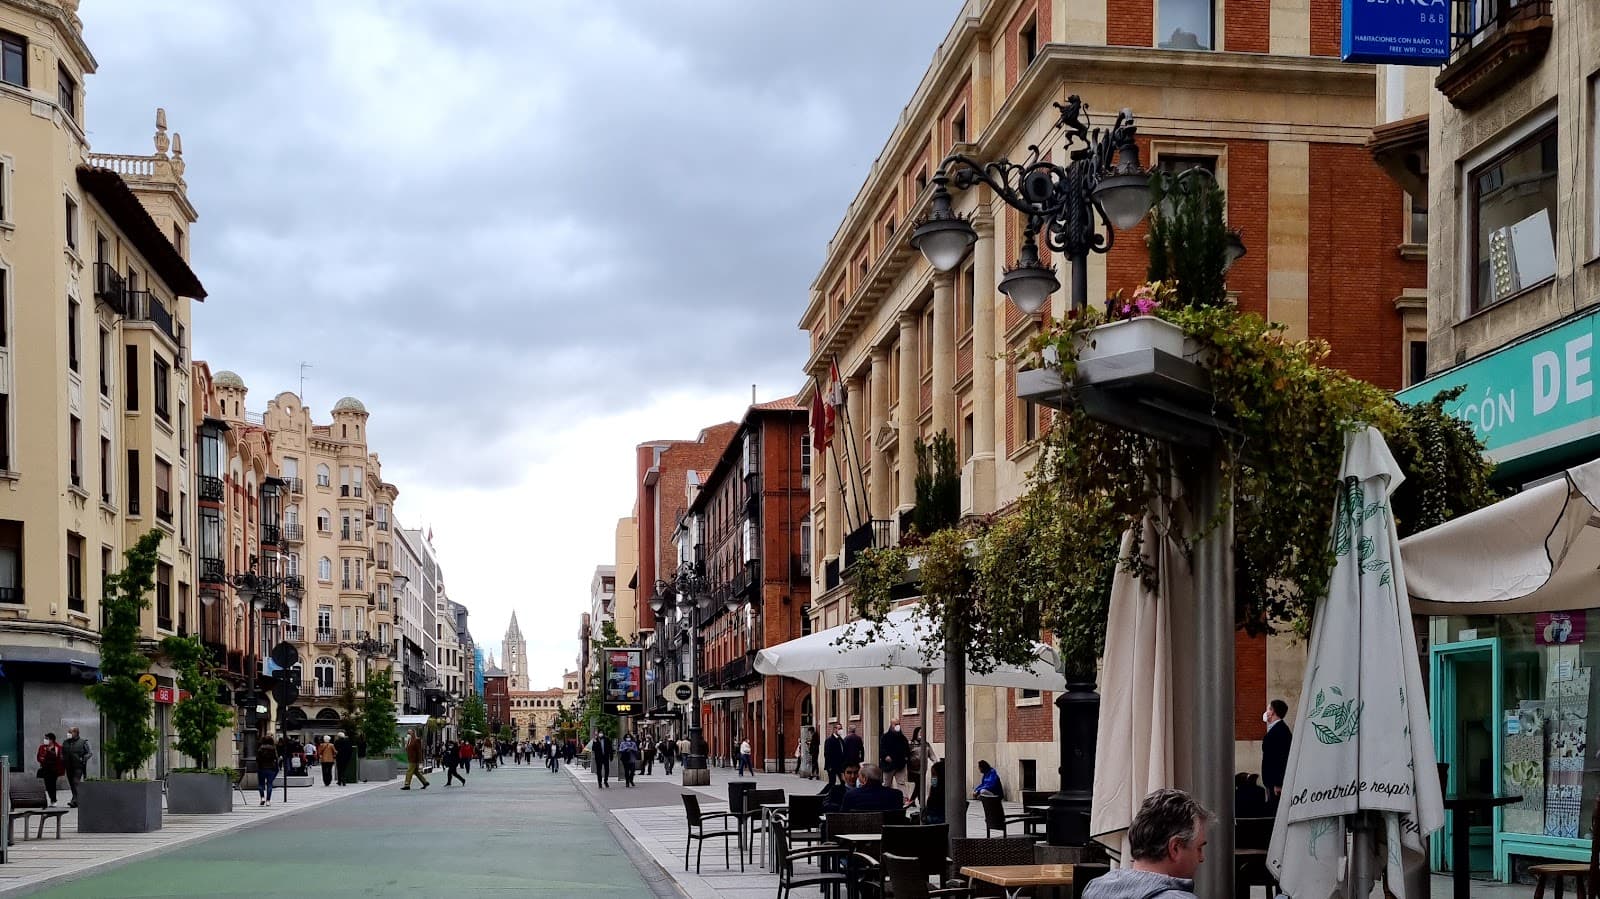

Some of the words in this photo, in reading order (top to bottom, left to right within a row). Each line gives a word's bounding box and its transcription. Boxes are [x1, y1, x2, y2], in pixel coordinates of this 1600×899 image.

[1420, 13, 1426, 23] B
[1429, 14, 1436, 23] &
[1438, 13, 1444, 24] B
[1354, 35, 1397, 43] HABITACIONES
[1412, 36, 1431, 45] BAÑO
[1389, 45, 1401, 53] FREE
[1532, 332, 1593, 416] DE
